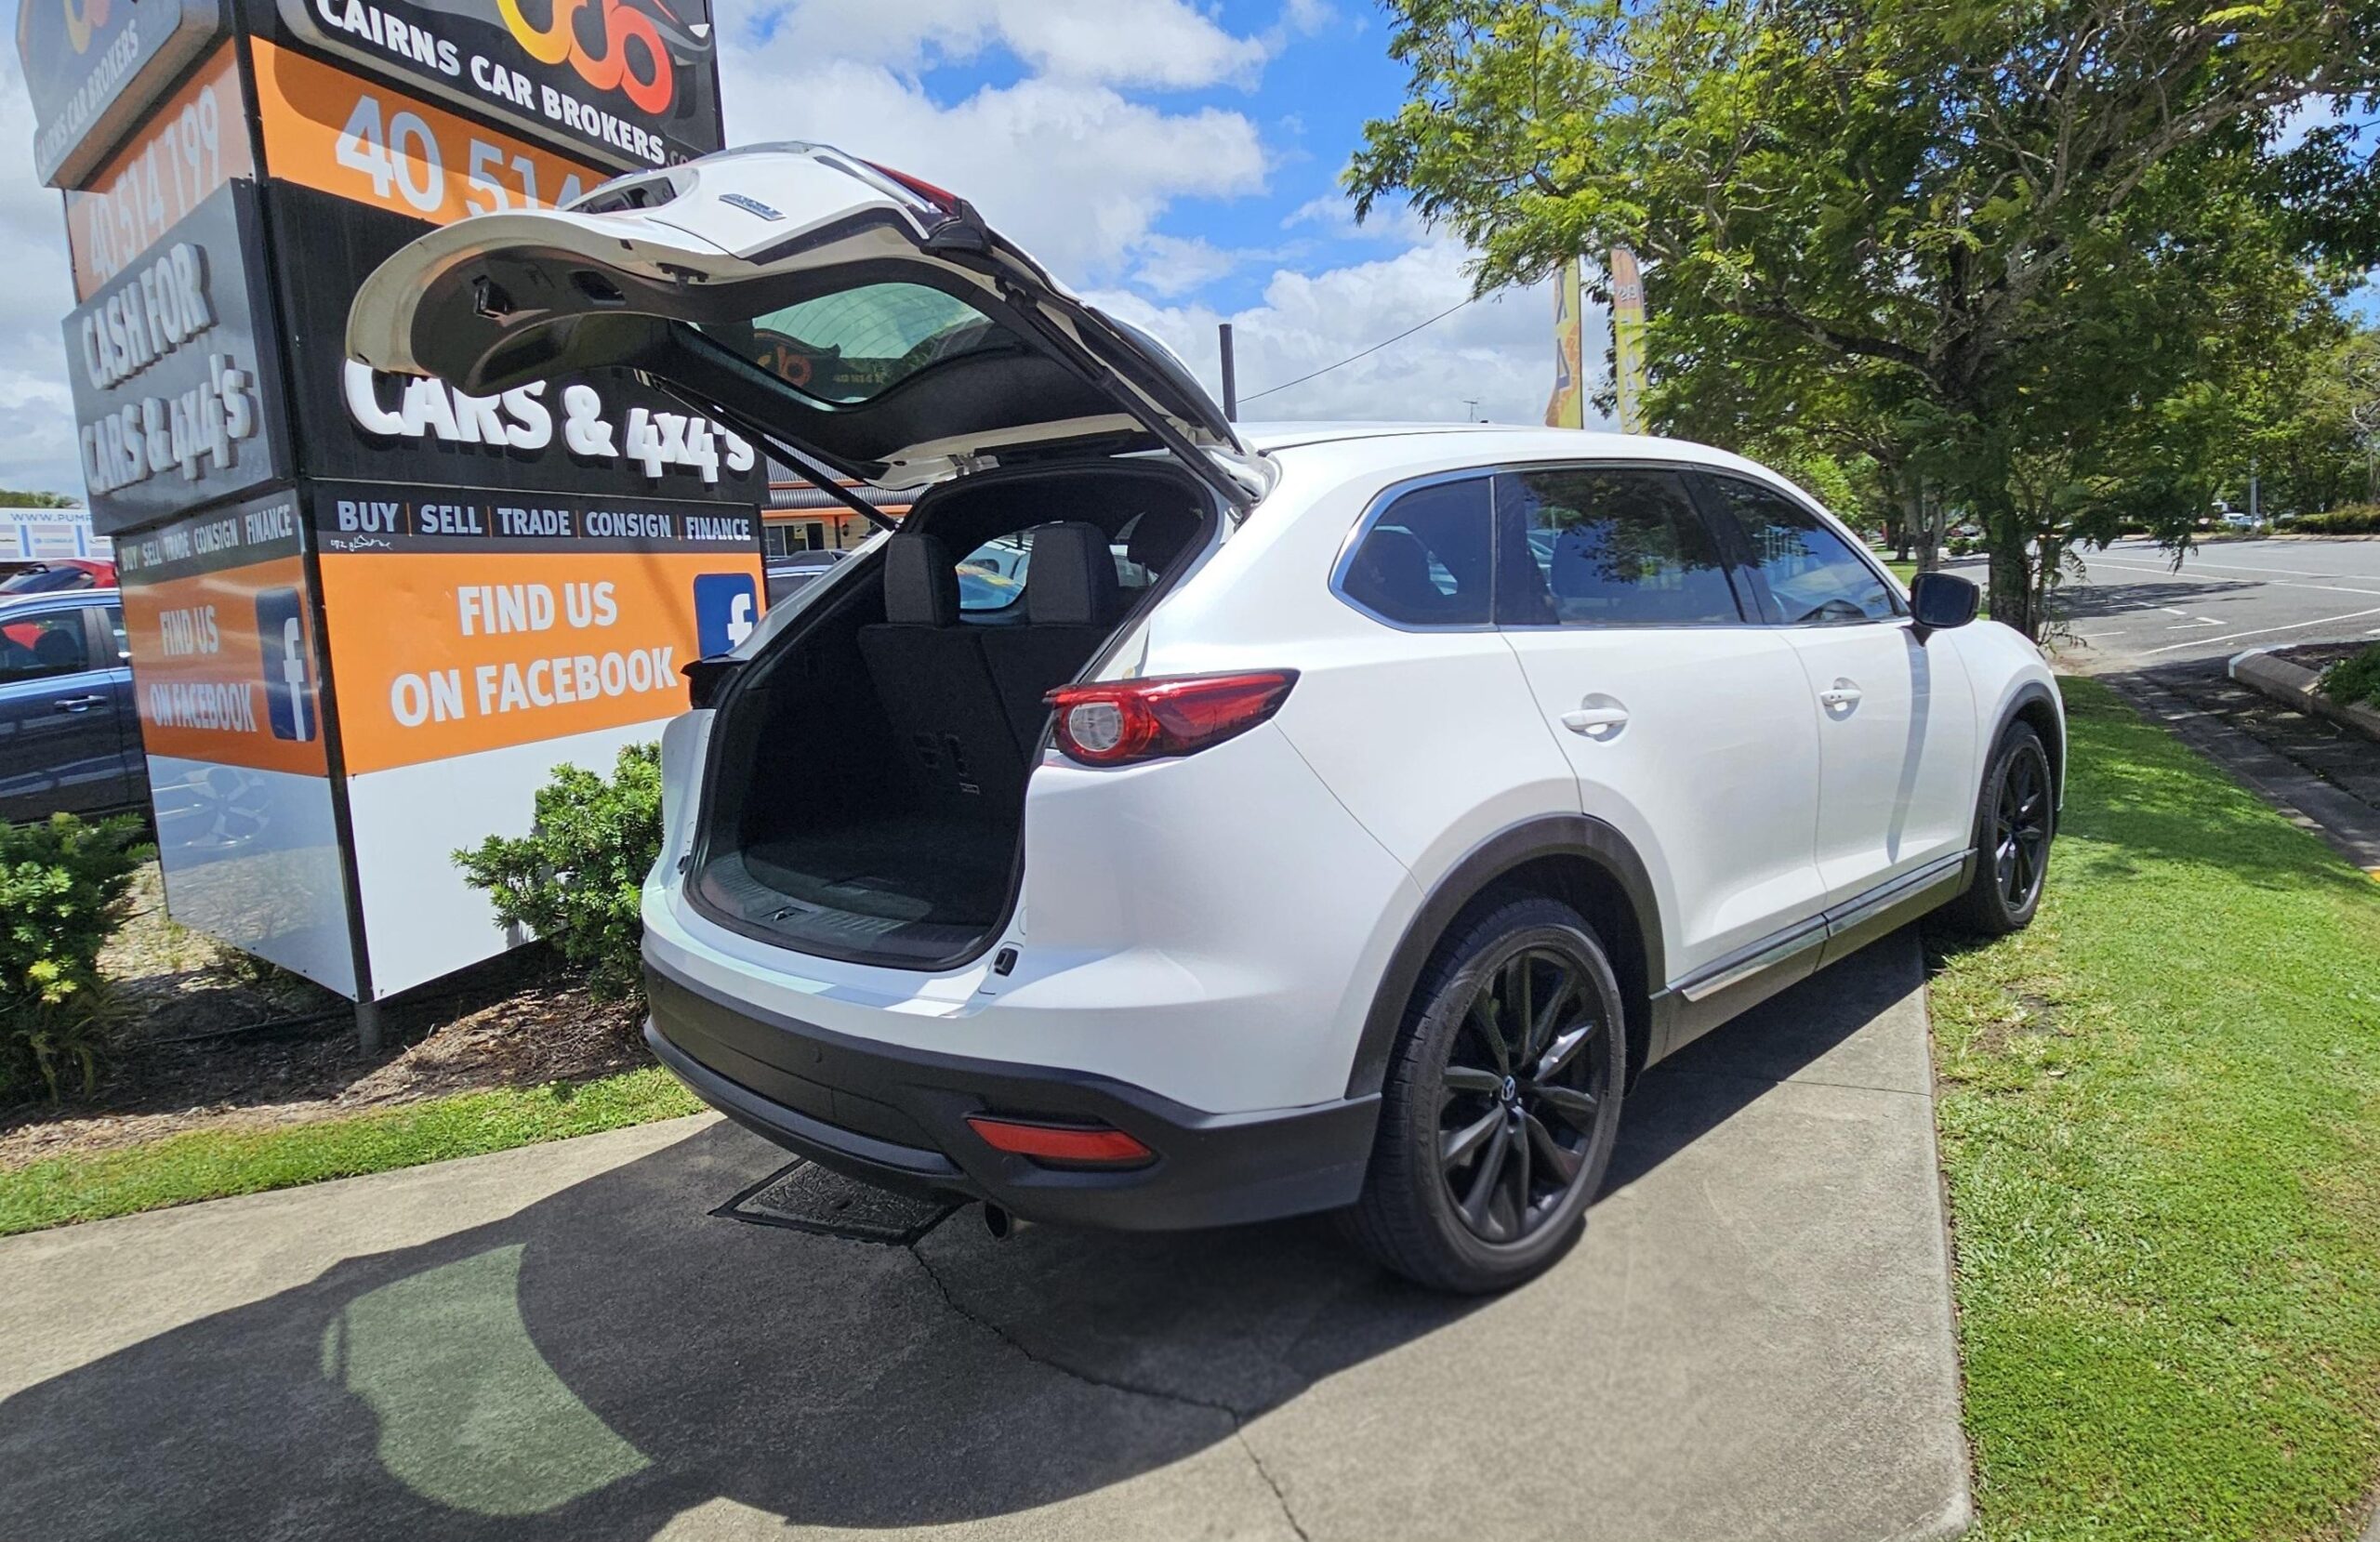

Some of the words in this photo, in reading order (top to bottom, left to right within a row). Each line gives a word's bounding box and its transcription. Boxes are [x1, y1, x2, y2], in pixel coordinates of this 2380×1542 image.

[66, 87, 88, 134] CAR
[87, 19, 139, 110] BROKERS
[316, 0, 461, 76] CAIRNS
[470, 56, 536, 111] CAR
[164, 85, 219, 218] 199
[335, 95, 444, 213] 40
[468, 138, 583, 216] 51
[83, 282, 156, 390] CASH
[140, 243, 212, 354] FOR
[80, 403, 149, 496] CARS
[142, 397, 177, 472] &
[345, 359, 553, 450] CARS
[564, 384, 619, 456] &
[121, 546, 139, 572] BUY
[142, 541, 163, 567] SELL
[163, 531, 191, 562] TRADE
[193, 519, 239, 555] CONSIGN
[245, 504, 293, 546] FINANCE
[337, 501, 399, 533] BUY
[420, 505, 483, 534] SELL
[497, 507, 571, 536] TRADE
[586, 511, 671, 538] CONSIGN
[686, 517, 751, 541] FINANCE
[159, 609, 193, 656] FIND
[194, 605, 219, 653] US
[458, 584, 555, 636] FIND
[565, 581, 618, 628] US
[150, 683, 173, 727] ON
[173, 683, 258, 732] FACEBOOK
[390, 669, 466, 727] ON
[475, 646, 678, 715] FACEBOOK
